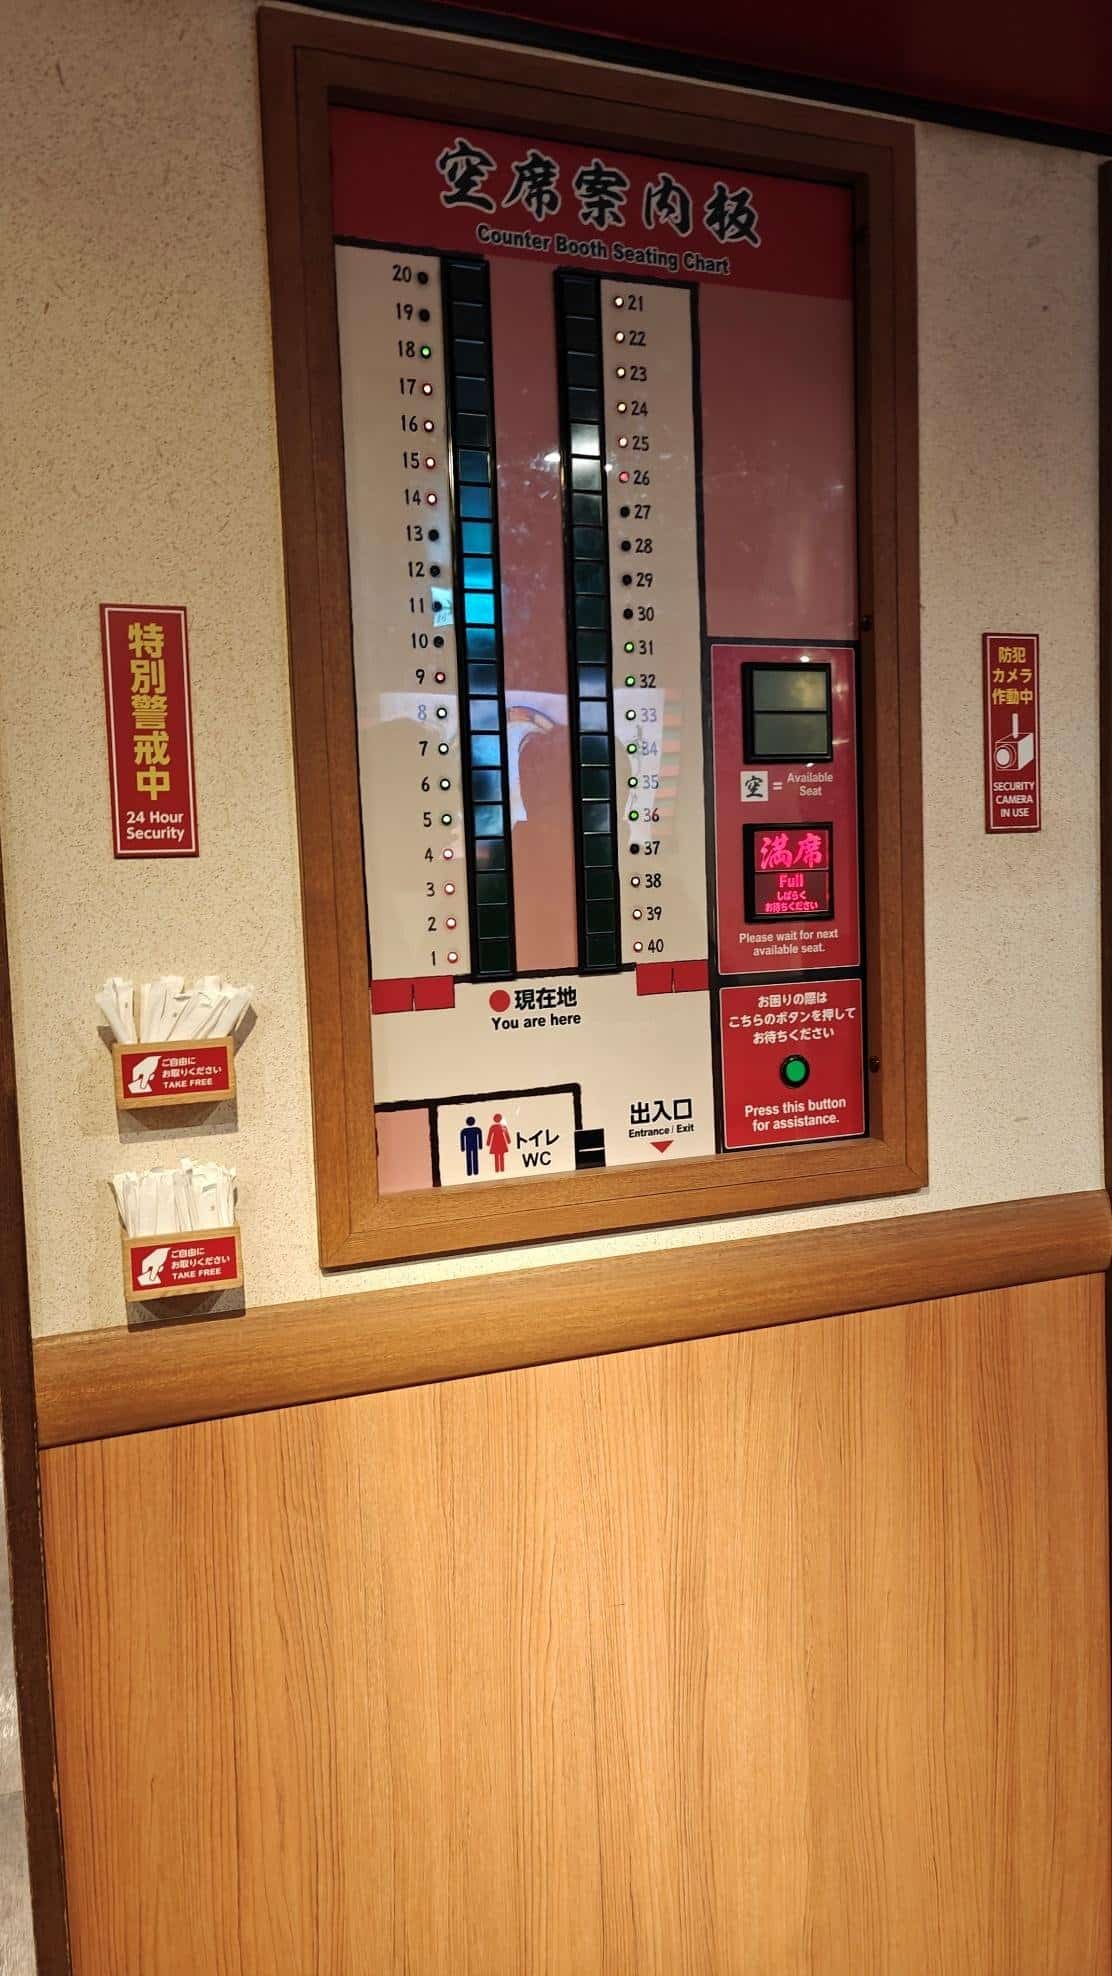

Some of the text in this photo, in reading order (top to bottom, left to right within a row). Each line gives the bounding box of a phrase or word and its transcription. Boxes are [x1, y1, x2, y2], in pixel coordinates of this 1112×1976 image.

[437, 138, 760, 247] 空席案内板
[477, 223, 730, 275] Counter Booth Seating Chart
[393, 264, 412, 283] 20
[628, 295, 643, 311] 21
[397, 303, 413, 320] 19
[629, 330, 646, 346] 22
[398, 340, 415, 357] 18
[630, 366, 647, 381] 23
[400, 378, 416, 394] 17
[632, 401, 648, 416] 24
[402, 415, 417, 432] 16
[633, 436, 649, 451] 25
[403, 452, 419, 469] 15
[634, 470, 649, 485] 26
[405, 489, 421, 505] 14
[635, 504, 651, 519] 27
[407, 525, 423, 541] 13
[636, 538, 652, 553] 28
[409, 562, 424, 577] 12
[637, 572, 653, 587] 29
[410, 598, 424, 613] 11
[638, 606, 654, 621] 30
[412, 633, 428, 648] 10
[639, 640, 653, 655] 31
[998, 647, 1026, 663] 防犯
[416, 669, 425, 684] 9
[640, 674, 656, 688] 32
[992, 668, 1032, 683] カメラ
[992, 688, 1033, 705] 作動中
[128, 622, 170, 800] 特別警戒中
[417, 704, 427, 720] 8
[641, 708, 657, 722] 33
[419, 741, 428, 756] 7
[641, 741, 658, 756] 34
[422, 777, 430, 792] 6
[643, 774, 659, 789] 35
[787, 772, 833, 784] Available
[744, 775, 764, 798] 空
[799, 786, 822, 797] Seat
[993, 781, 1035, 792] SECURITY
[996, 794, 1033, 805] CAMERA
[127, 811, 184, 824] 24 Hour
[424, 812, 432, 827] 5
[644, 808, 659, 822] 36
[1000, 807, 1030, 817] IN USE
[127, 826, 185, 842] Security
[425, 848, 433, 862] 4
[645, 841, 660, 855] 37
[760, 833, 822, 869] 満席
[646, 873, 661, 888] 38
[779, 873, 804, 888] Full
[427, 882, 435, 897] 3
[777, 891, 807, 901] しばらく
[647, 906, 661, 920] 39
[765, 901, 818, 913] お待ちください
[428, 917, 436, 931] 2
[739, 929, 838, 944] Please wait for next
[648, 939, 664, 953] 40
[753, 943, 825, 956] available seat.
[432, 951, 435, 966] 1
[515, 986, 577, 1010] 現在地
[758, 992, 828, 1008] お困りの際は
[492, 1013, 581, 1030] You are here
[729, 1007, 856, 1028] こちらのボタンを押して
[752, 1027, 835, 1045] お待ちください
[161, 1057, 196, 1067] ご自由に
[162, 1066, 222, 1078] お取りください
[163, 1078, 213, 1089] TAKE FREE
[630, 1098, 692, 1124] 出入口
[745, 1098, 846, 1117] Press this button
[752, 1113, 840, 1132] for assistance.
[629, 1127, 670, 1138] Entrance
[677, 1123, 694, 1134] Exit
[516, 1129, 560, 1149] トイレ
[522, 1152, 551, 1168] WC
[171, 1248, 205, 1258] ご自由に
[172, 1256, 230, 1269] お取りください
[172, 1268, 221, 1280] TAKE FREE
